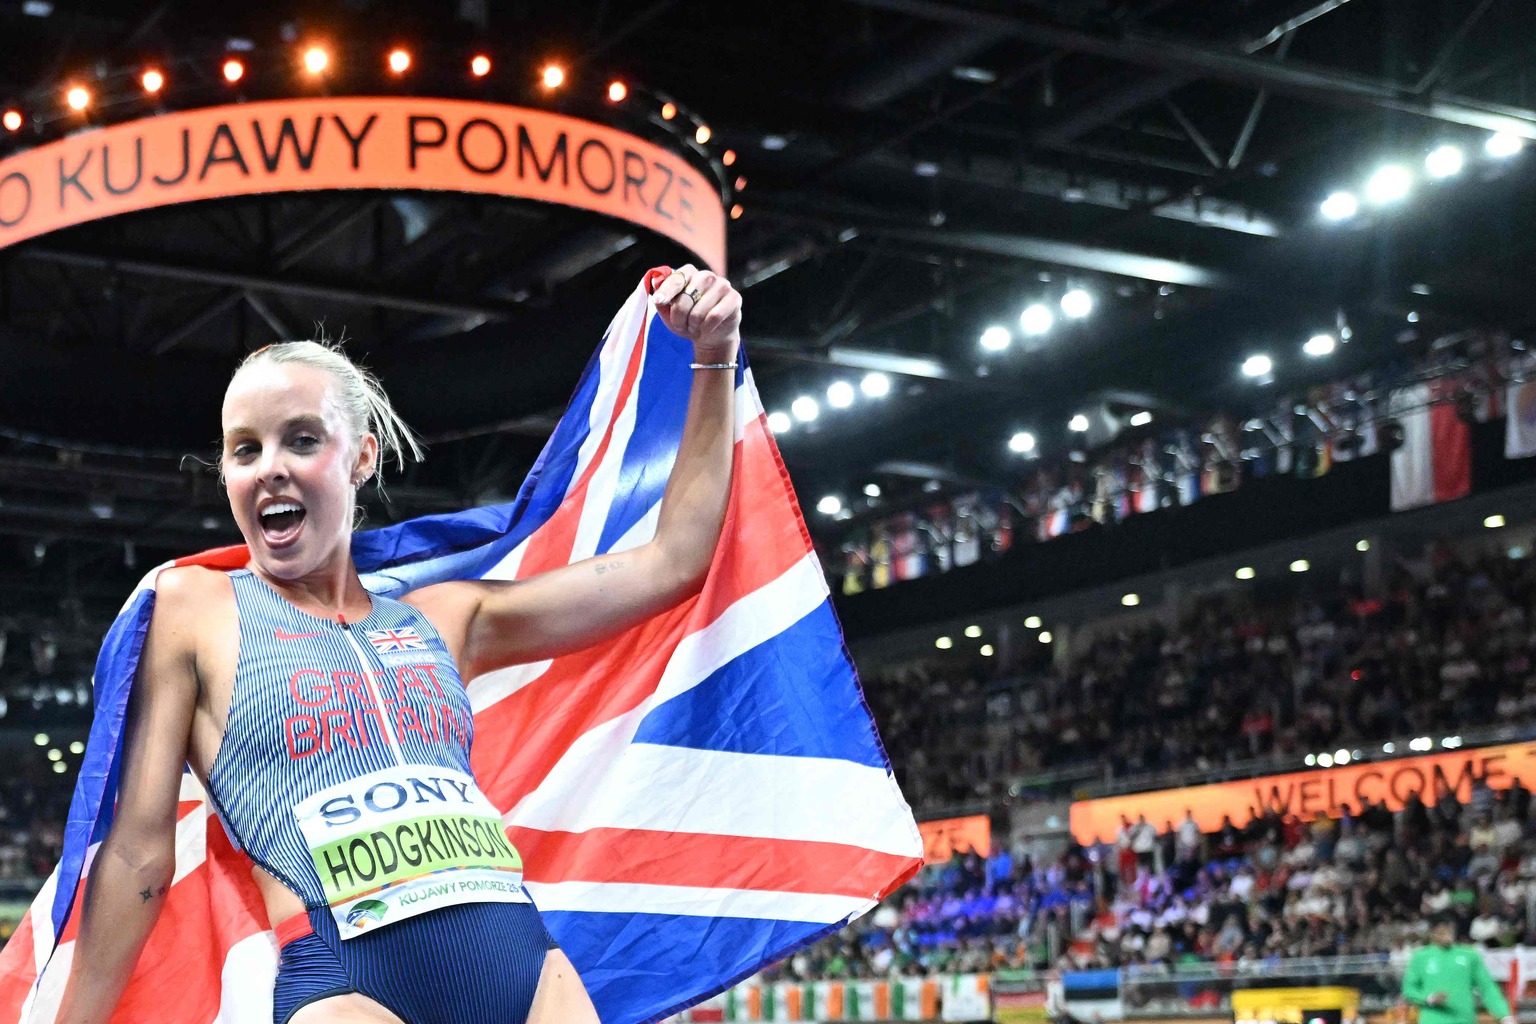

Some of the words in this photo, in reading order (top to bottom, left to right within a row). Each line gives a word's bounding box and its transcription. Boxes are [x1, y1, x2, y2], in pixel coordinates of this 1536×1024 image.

[58, 114, 378, 211] KUJAWY
[407, 114, 697, 234] POMORZE
[290, 665, 445, 708] GREAT
[285, 703, 467, 760] BRITAIN
[319, 776, 474, 828] SONY
[1255, 753, 1506, 815] WELCOME
[322, 816, 514, 892] HODGKINSON
[398, 882, 457, 906] KUJAWY
[459, 880, 507, 893] POMORZE
